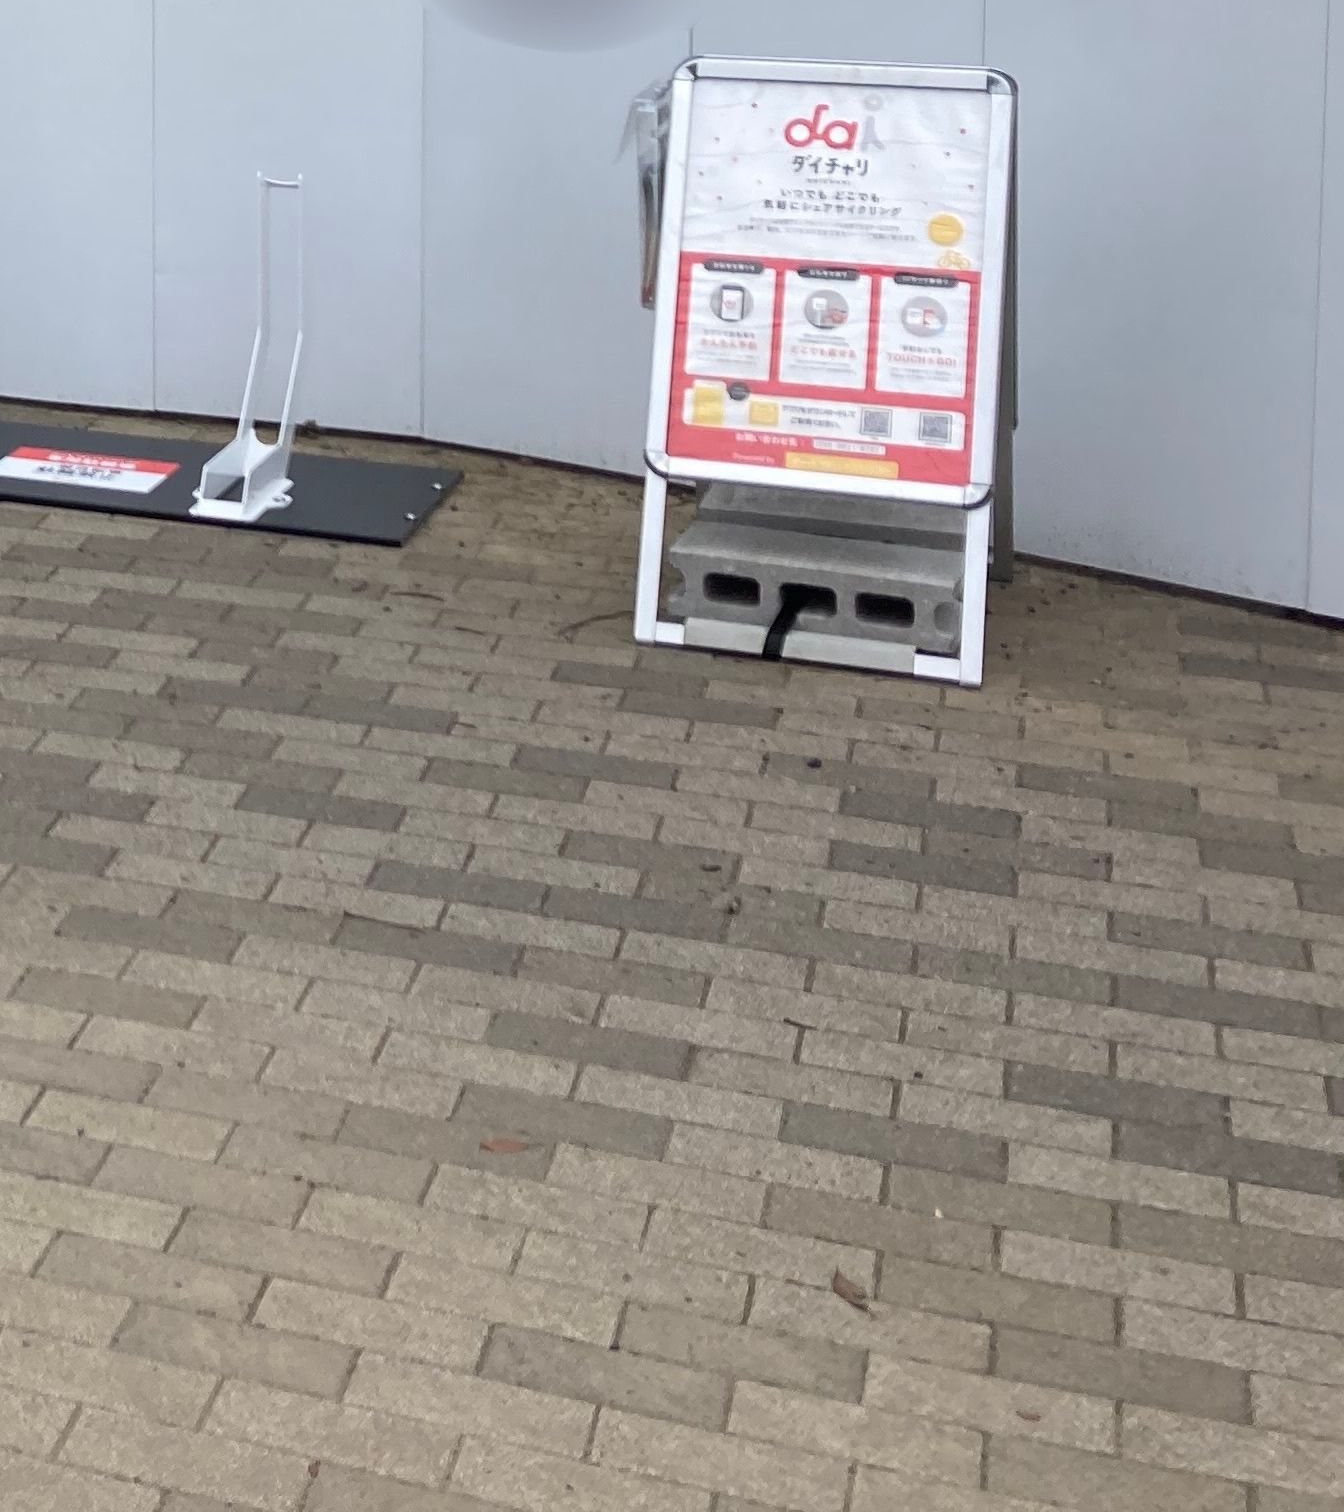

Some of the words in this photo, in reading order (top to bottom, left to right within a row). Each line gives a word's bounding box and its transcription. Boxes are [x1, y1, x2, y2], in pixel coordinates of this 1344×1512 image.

[792, 154, 869, 177] ダイチャリ
